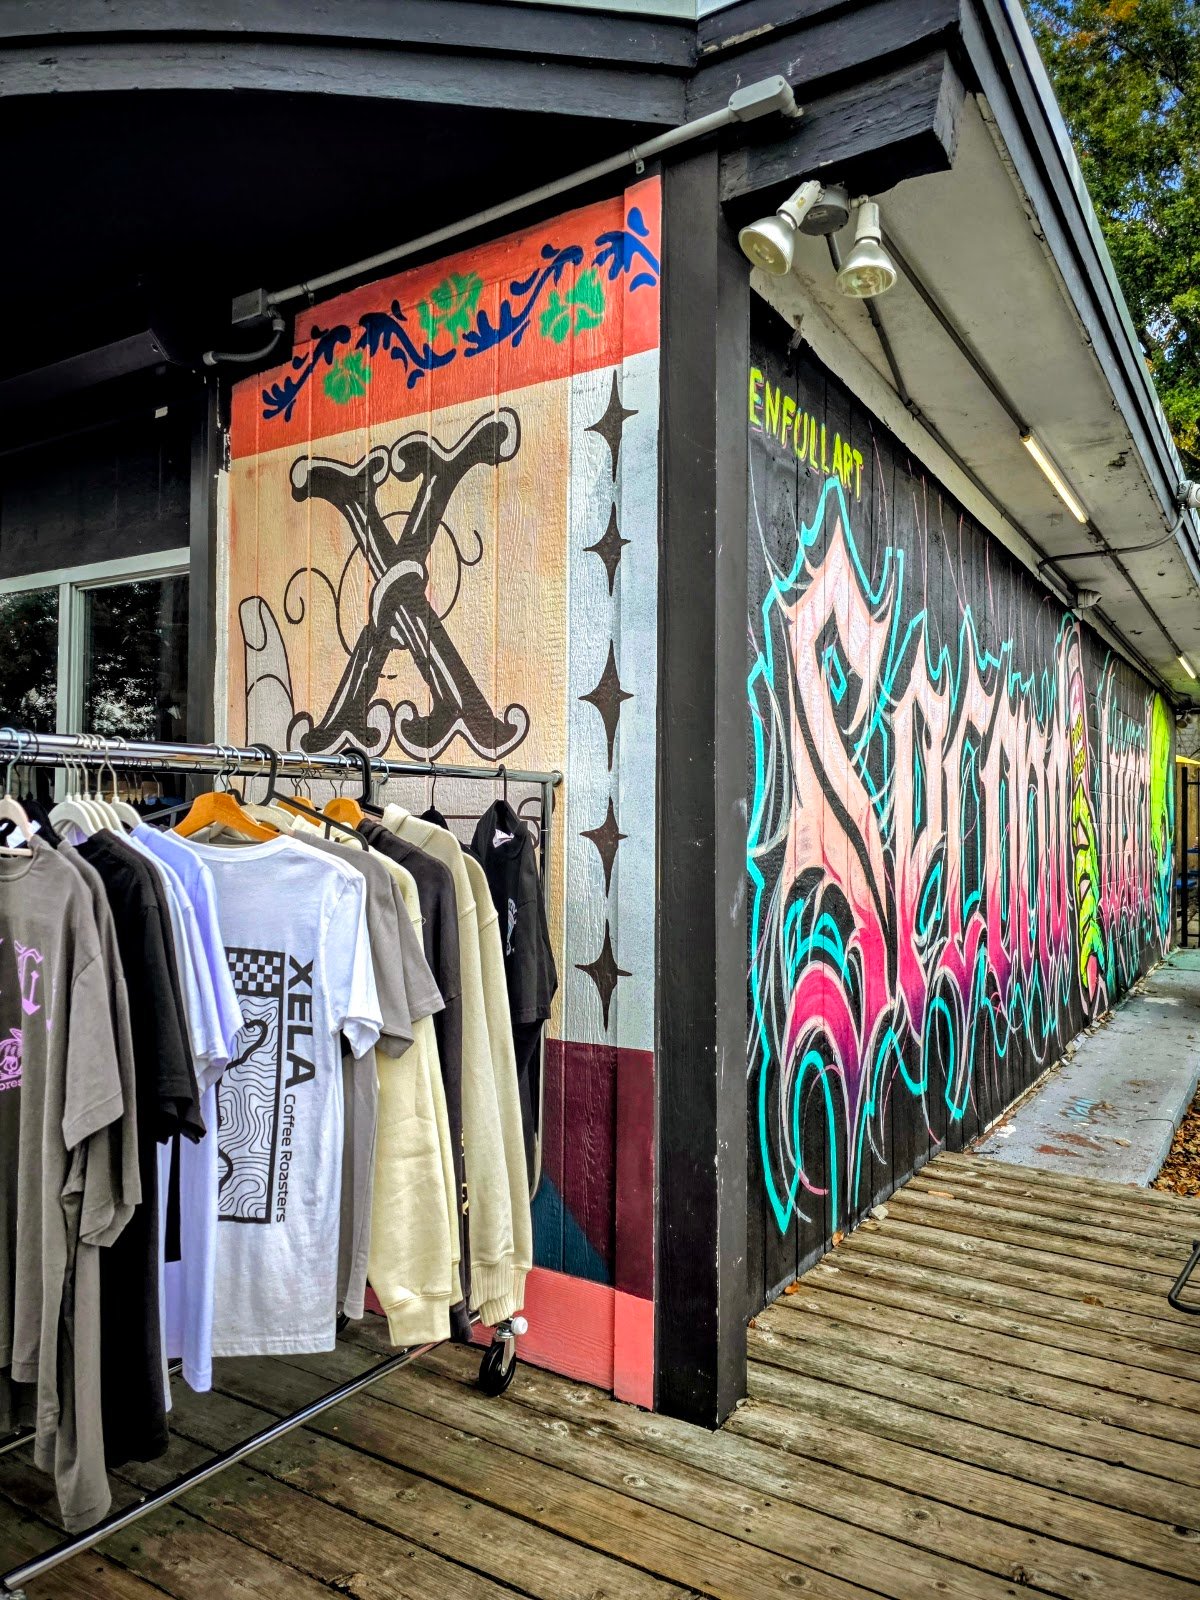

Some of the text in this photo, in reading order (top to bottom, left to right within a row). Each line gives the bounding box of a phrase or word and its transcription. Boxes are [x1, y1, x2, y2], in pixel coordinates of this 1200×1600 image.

[276, 954, 316, 1224] XELA Coffee Roasters
